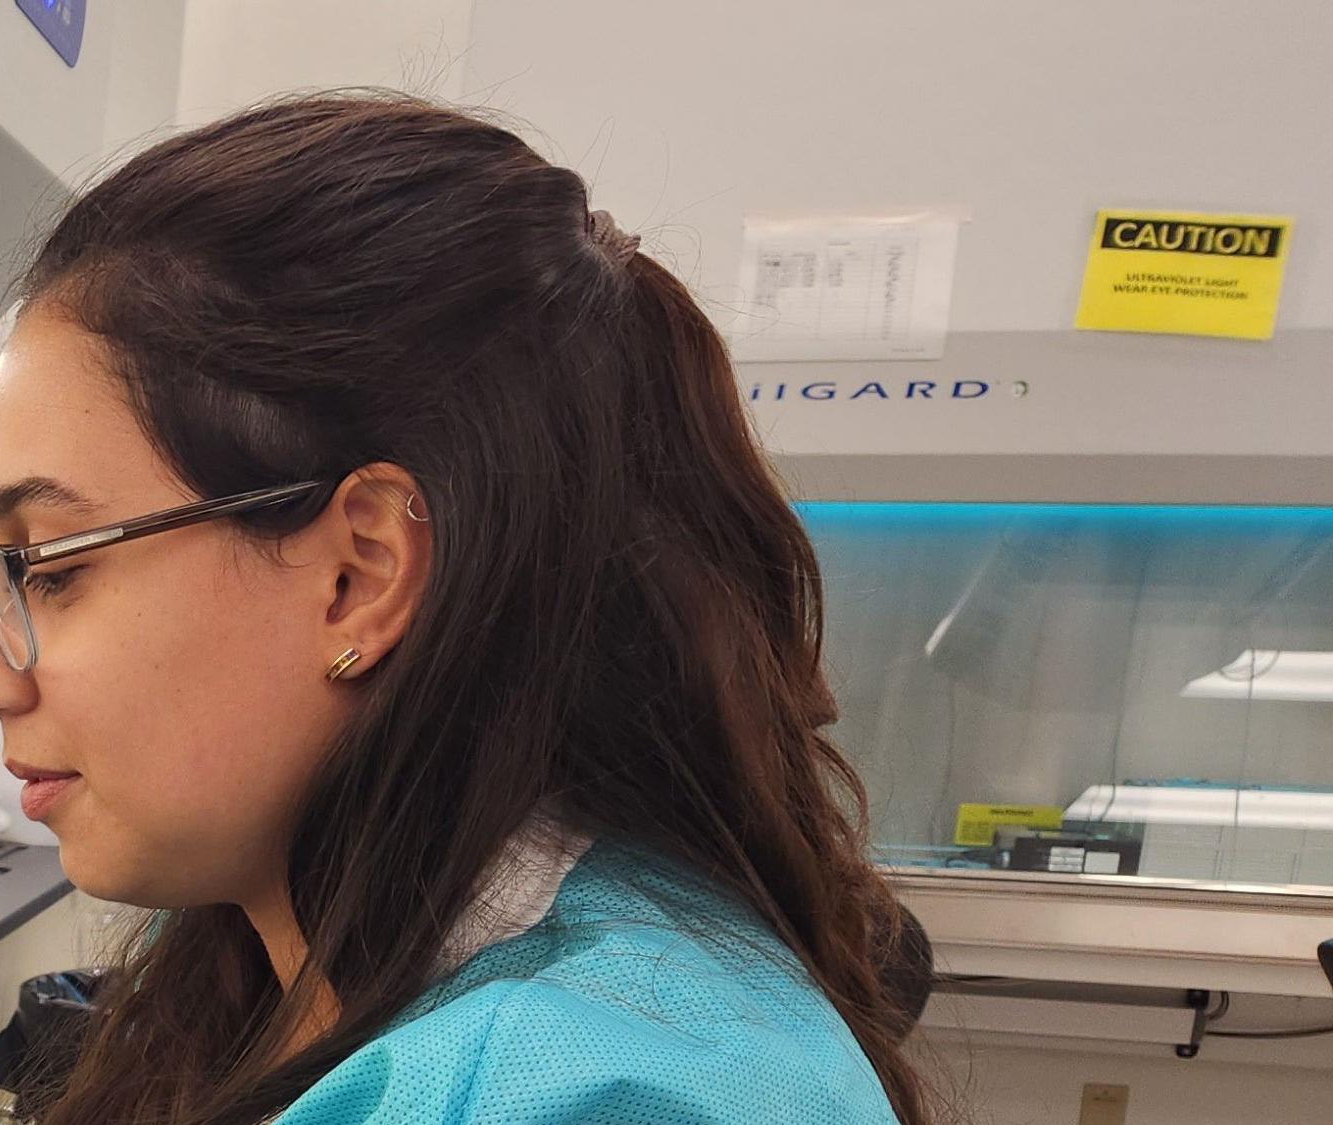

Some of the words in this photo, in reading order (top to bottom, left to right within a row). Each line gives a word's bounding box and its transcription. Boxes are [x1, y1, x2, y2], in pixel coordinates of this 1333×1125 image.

[1114, 222, 1273, 256] CAUTION
[1113, 284, 1148, 294] WEAR
[1151, 285, 1171, 295] EYE
[1174, 286, 1248, 300] PROTECTION
